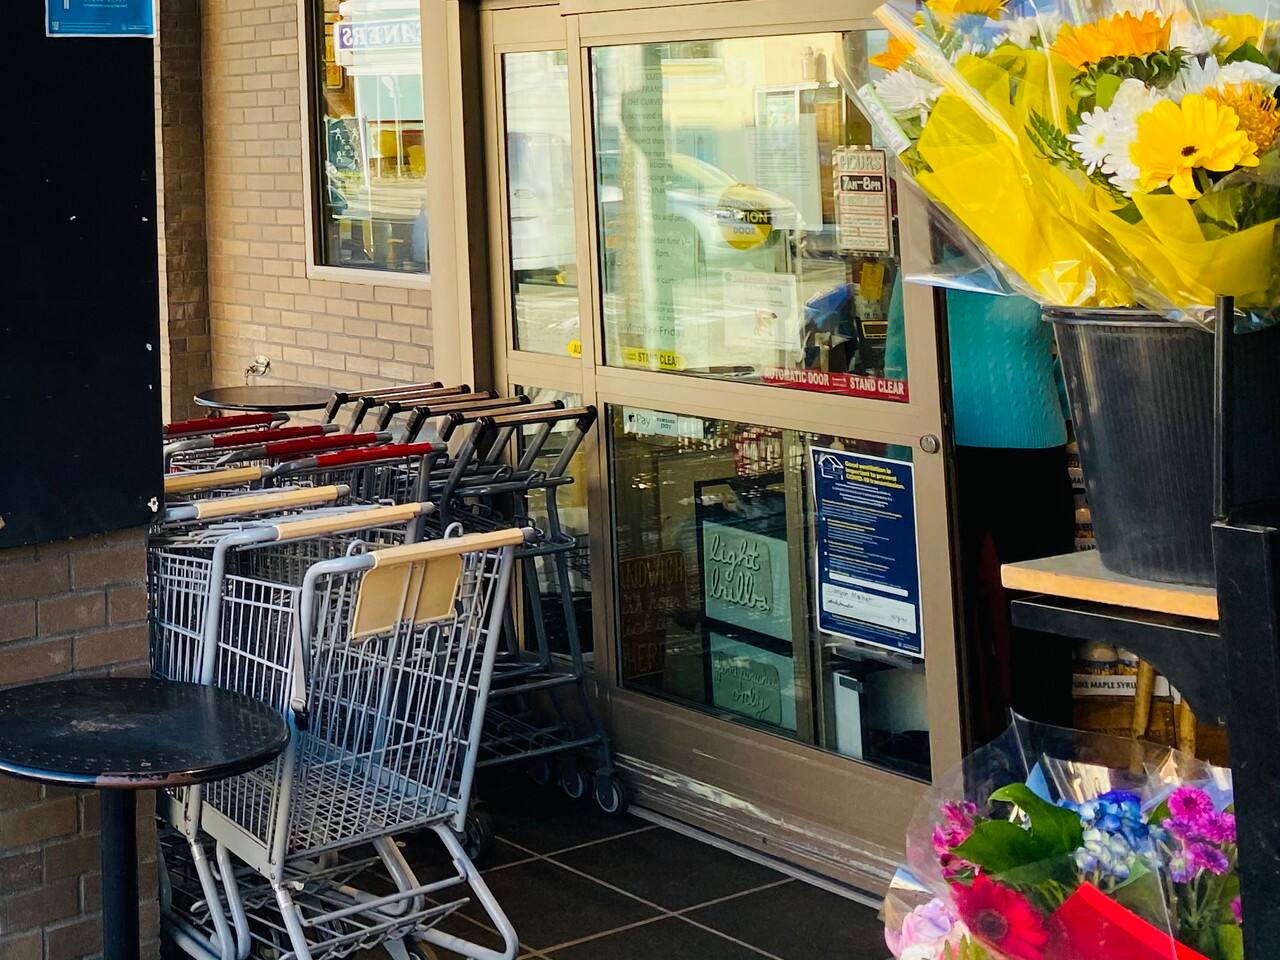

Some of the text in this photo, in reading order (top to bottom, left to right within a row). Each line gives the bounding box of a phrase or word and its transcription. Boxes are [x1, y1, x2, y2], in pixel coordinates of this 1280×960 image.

[841, 154, 881, 170] HOURS
[808, 372, 830, 387] DOOR
[850, 377, 876, 392] STAND
[877, 380, 905, 395] CLEAR
[710, 534, 761, 582] light
[1090, 681, 1115, 689] MAPLE
